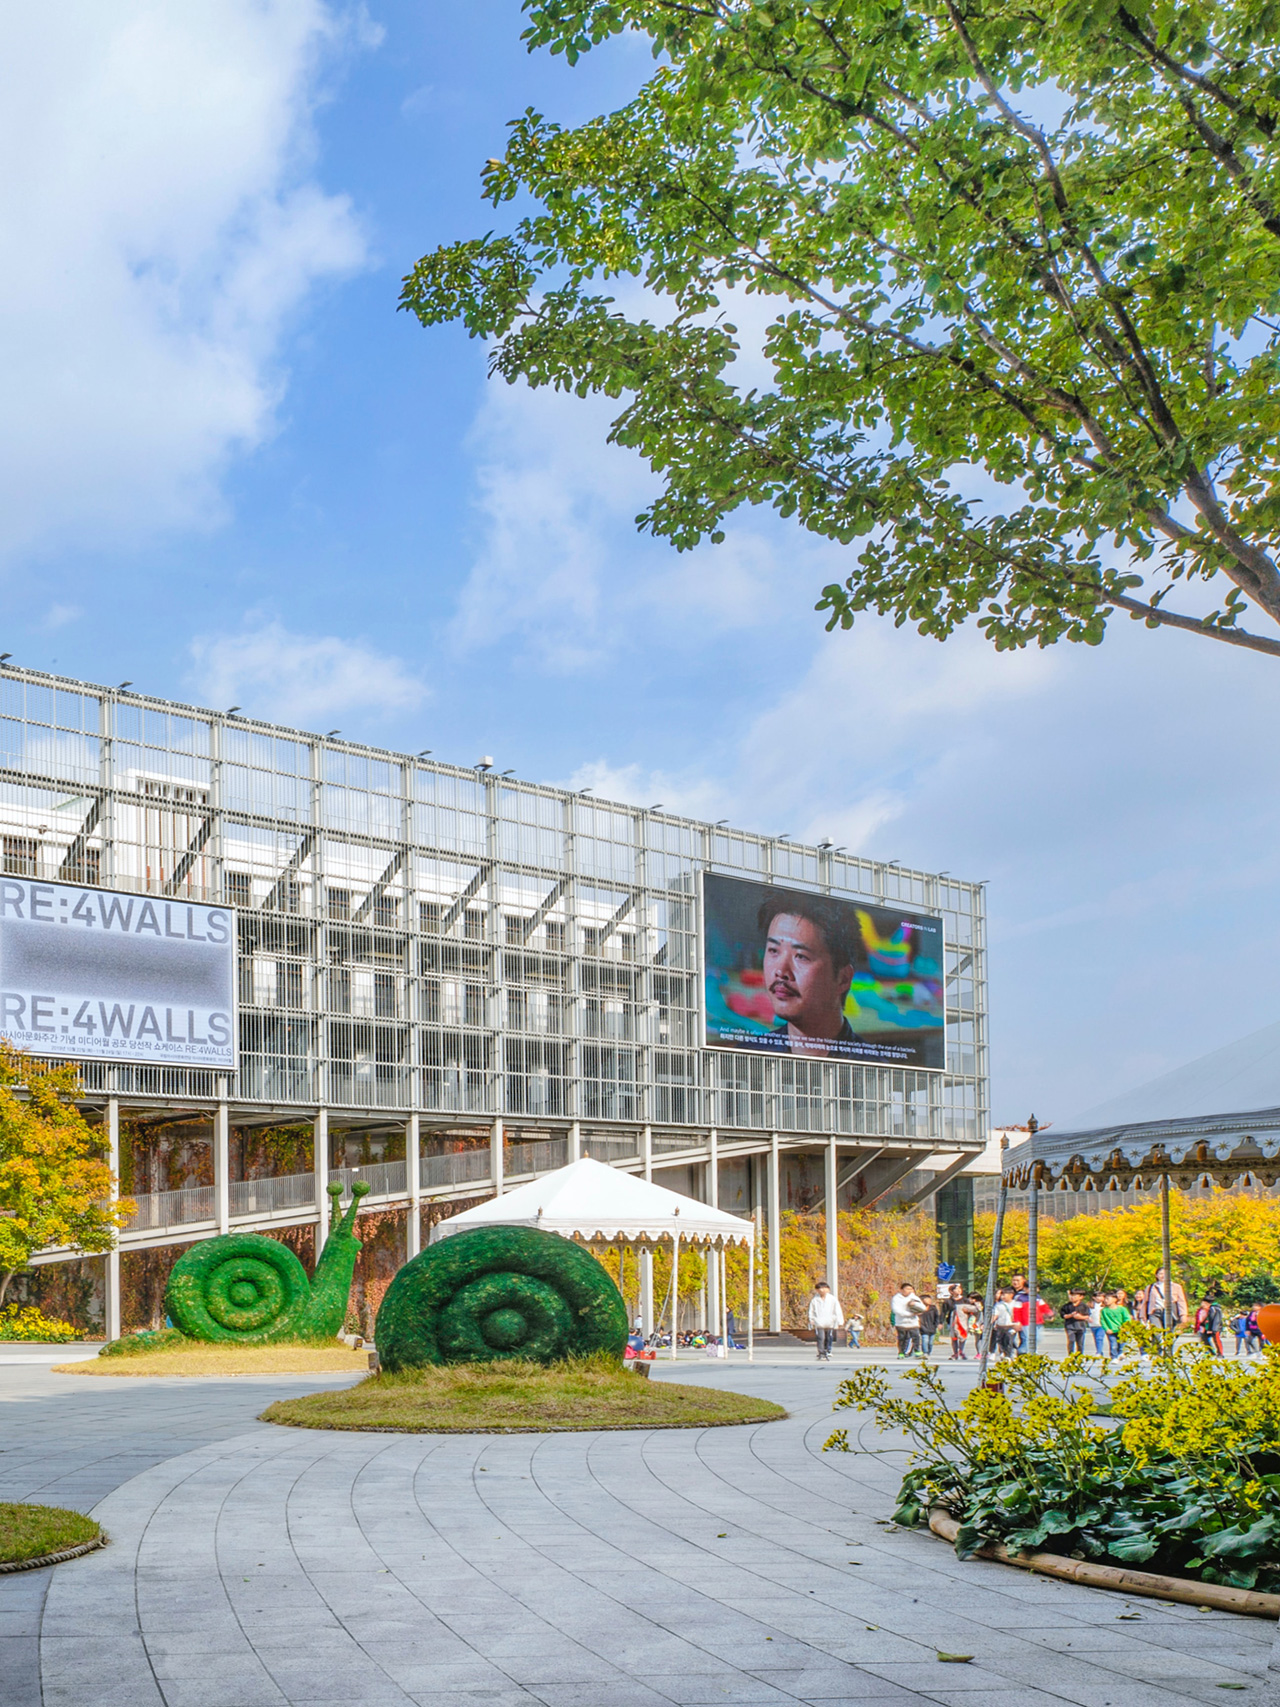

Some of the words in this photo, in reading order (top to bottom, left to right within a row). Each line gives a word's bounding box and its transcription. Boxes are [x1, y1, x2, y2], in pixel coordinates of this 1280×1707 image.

[0, 880, 229, 944] RE:4WALLS
[0, 992, 231, 1046] RE:4WALLS
[0, 1030, 58, 1043] 아시아문화주간
[60, 1034, 76, 1045] 기념
[78, 1036, 110, 1048] 미디어월
[111, 1039, 127, 1048] 공모
[129, 1040, 153, 1050] 당선작
[154, 1043, 183, 1052] 쇼케이스
[185, 1045, 232, 1056] RE:4WALLS
[847, 1040, 861, 1048] society
